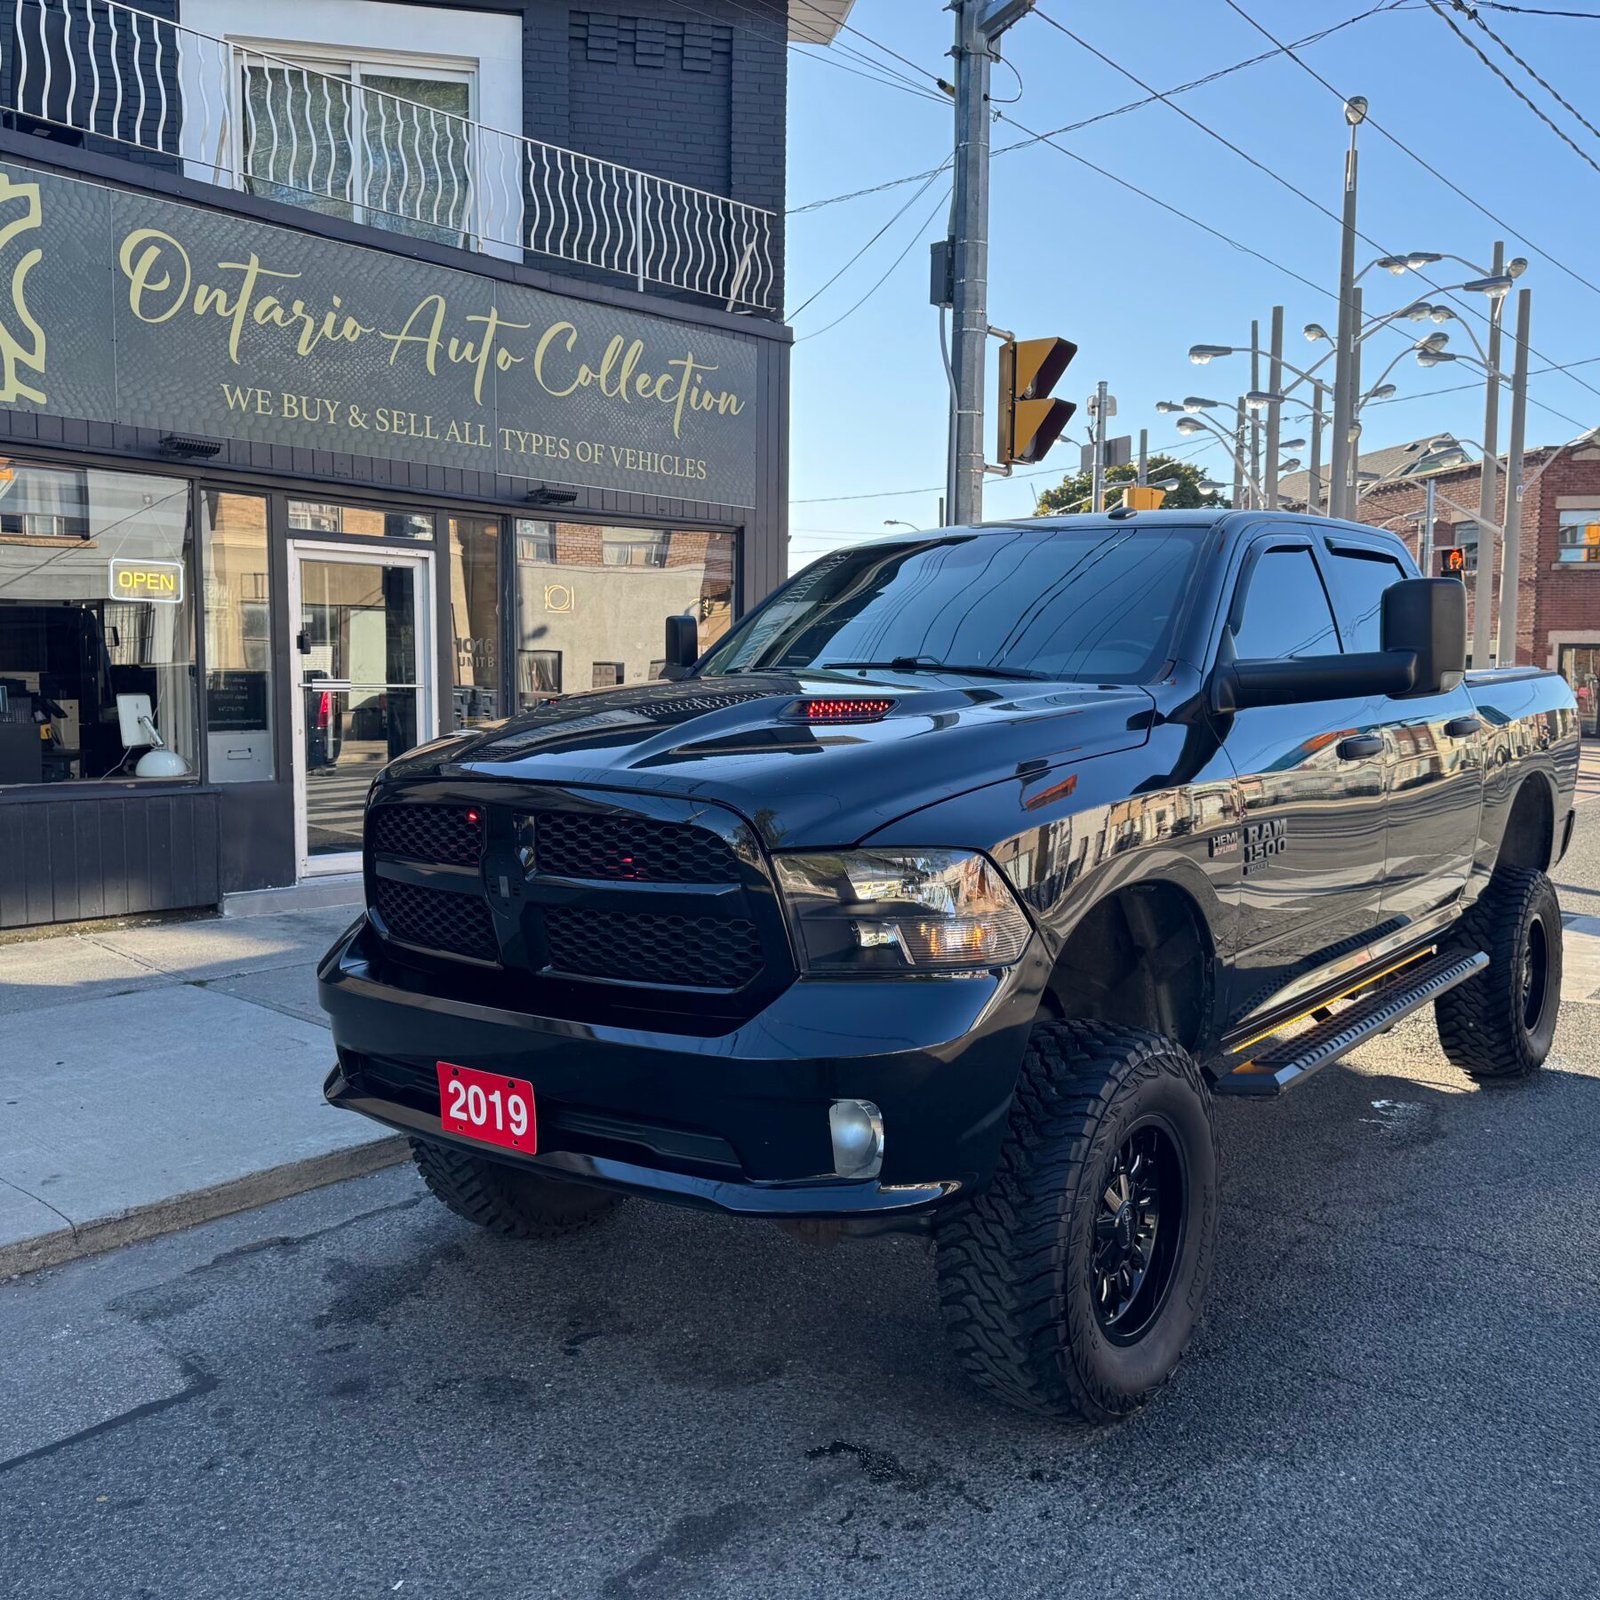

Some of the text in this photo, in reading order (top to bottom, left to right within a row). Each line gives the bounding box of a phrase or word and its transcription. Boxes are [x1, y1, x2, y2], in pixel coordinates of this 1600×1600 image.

[119, 228, 745, 439] Ontario Auto Collection
[220, 383, 708, 480] WE BUY & SELL ALL TYPES OF VEHICLES
[118, 571, 174, 592] OPEN
[453, 637, 494, 654] 1016
[458, 656, 495, 668] UNIT B
[1212, 832, 1238, 848] HEMI
[1246, 818, 1288, 843] RAM
[1246, 837, 1288, 863] 1500
[448, 1079, 528, 1136] 2019
